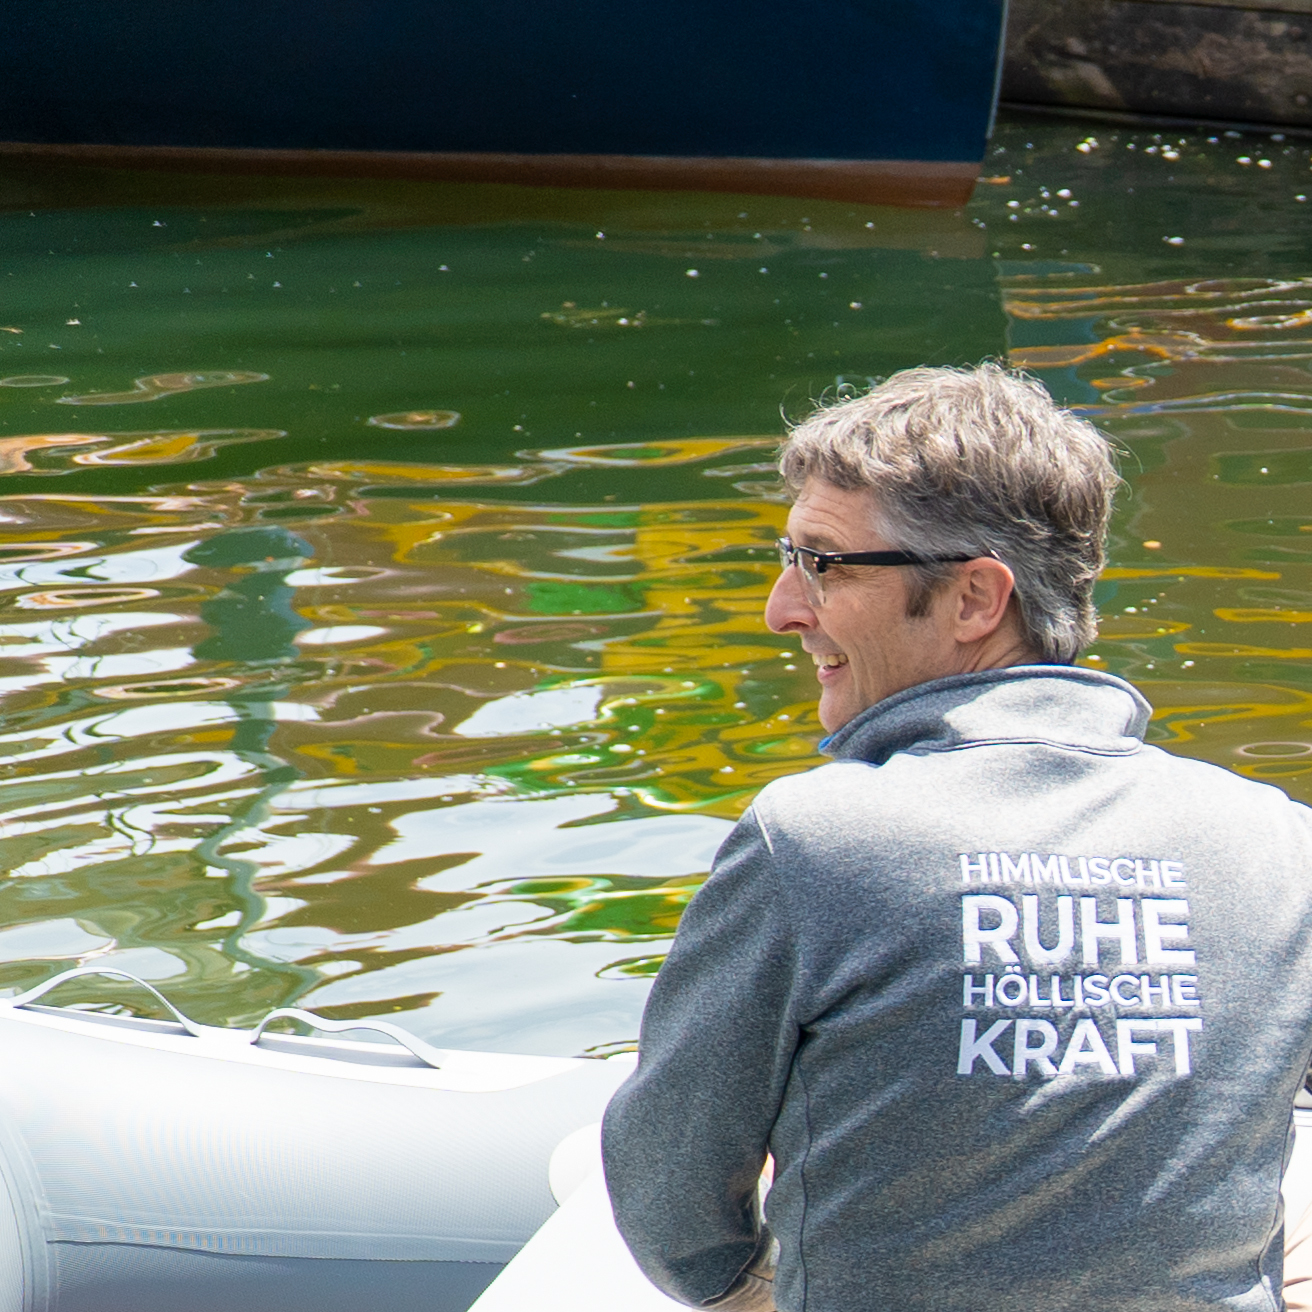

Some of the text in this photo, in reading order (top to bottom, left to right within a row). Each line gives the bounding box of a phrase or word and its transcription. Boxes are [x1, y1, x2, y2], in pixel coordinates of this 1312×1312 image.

[959, 852, 1187, 888] HIMMLISCHE
[961, 893, 1196, 965] RUHE
[963, 965, 1200, 1007] HÖLLISCHE
[957, 1018, 1203, 1076] KRAFT
